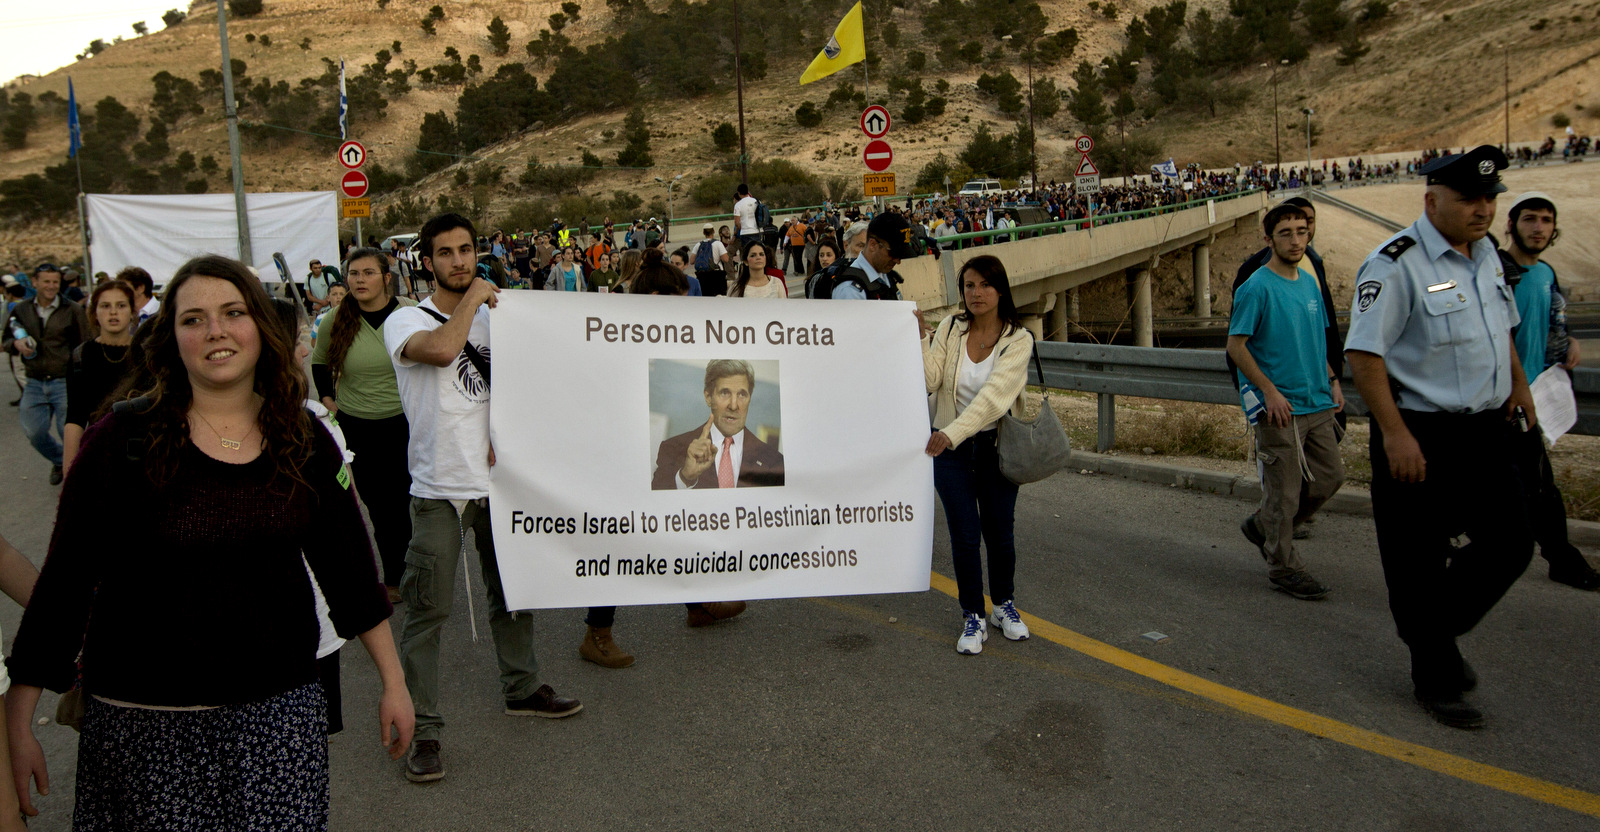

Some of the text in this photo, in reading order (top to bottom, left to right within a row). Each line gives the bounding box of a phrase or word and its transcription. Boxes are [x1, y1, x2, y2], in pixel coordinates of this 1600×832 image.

[1078, 140, 1090, 149] 30
[585, 316, 836, 346] Persona Non Grata
[511, 501, 914, 535] Forces Israel to release Palestinian terrorists
[575, 545, 858, 578] and make suicidal concessions
